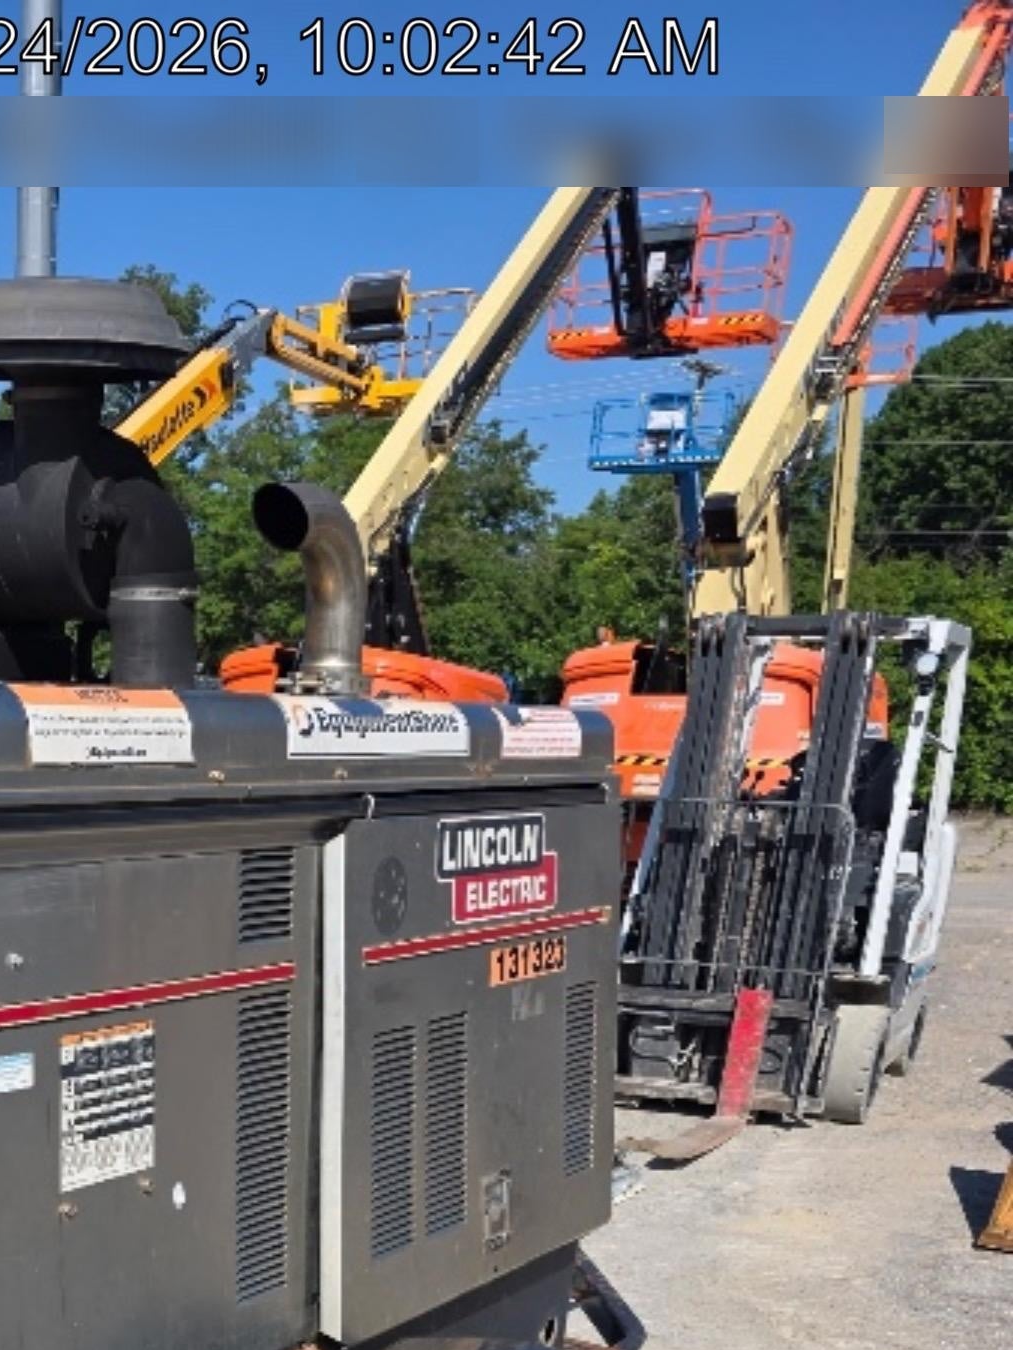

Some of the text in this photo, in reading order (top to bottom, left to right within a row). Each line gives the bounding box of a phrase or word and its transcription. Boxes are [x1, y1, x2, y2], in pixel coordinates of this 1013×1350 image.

[442, 824, 539, 871] LINCOLN
[465, 875, 547, 913] ELECTRIC
[496, 938, 564, 983] 131323
